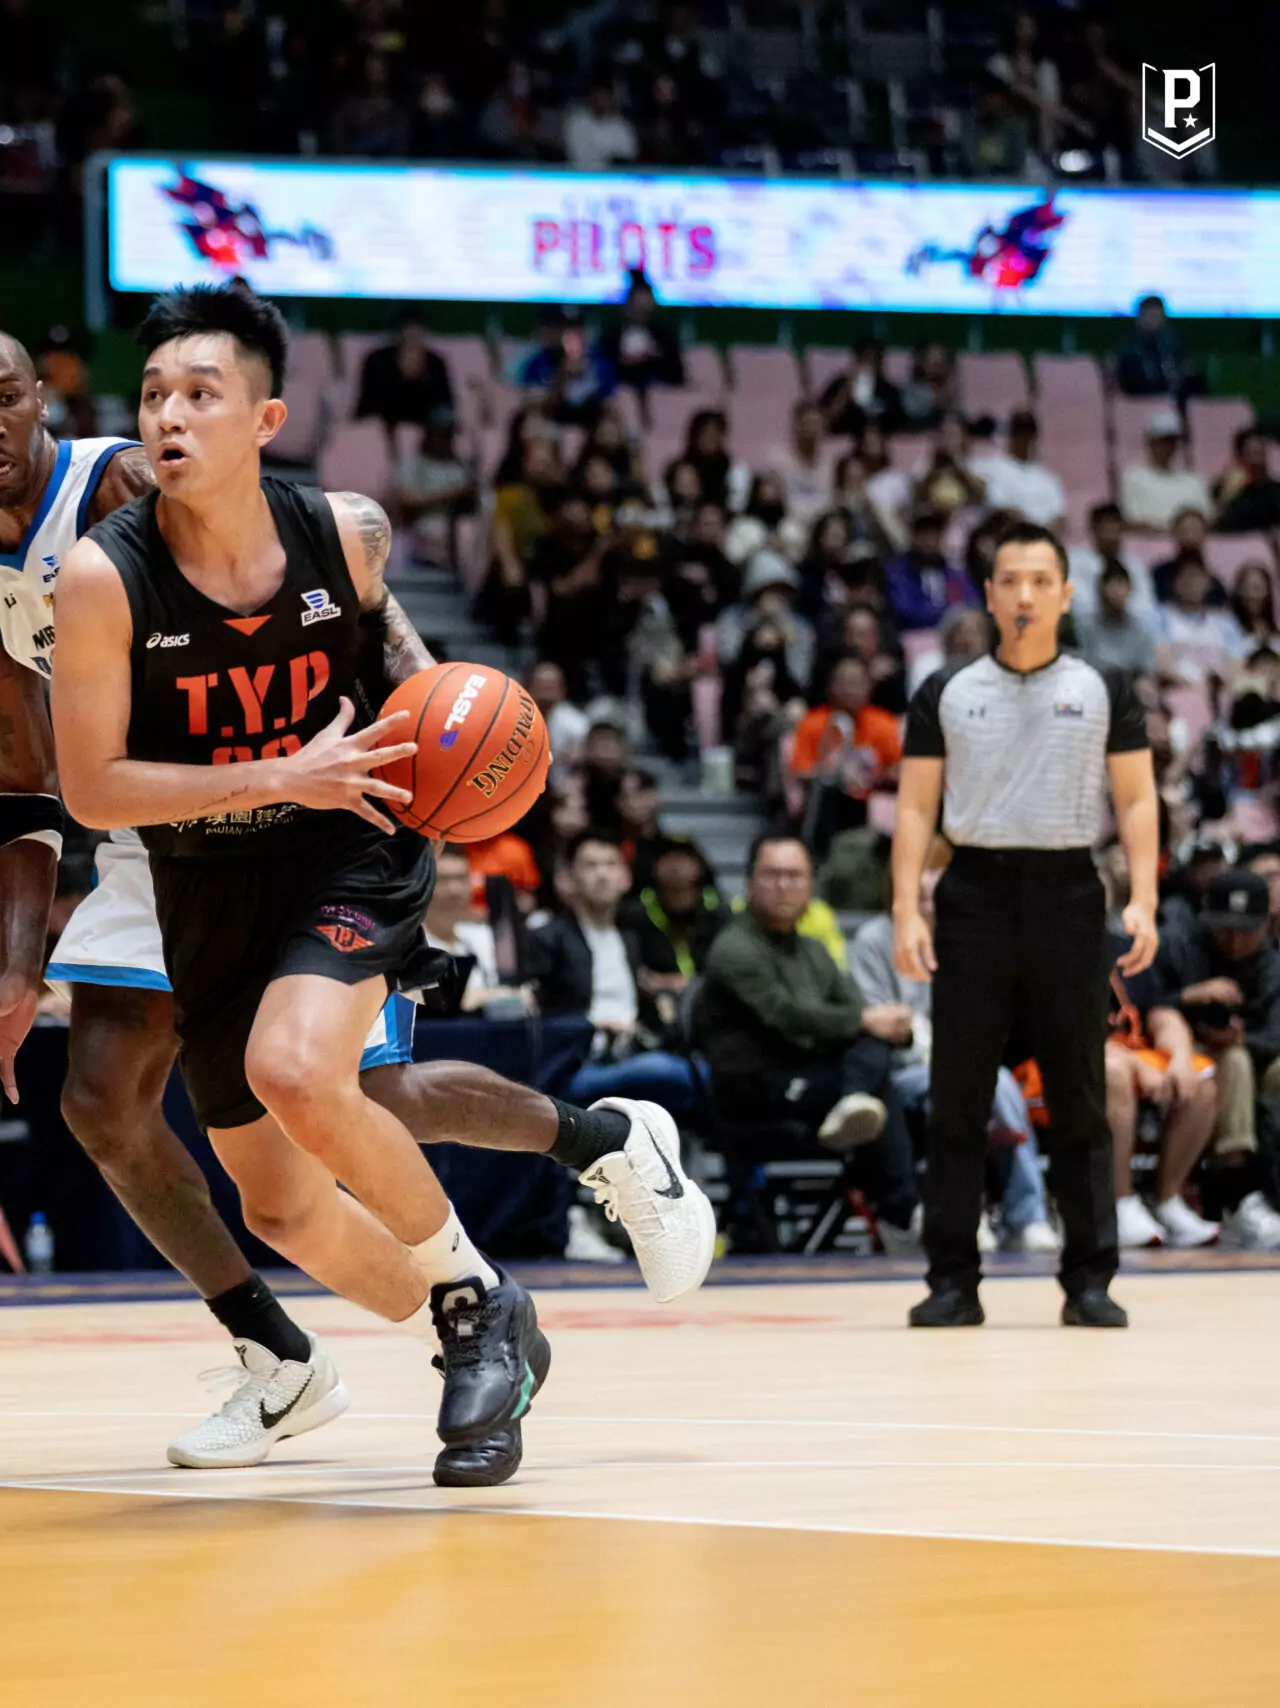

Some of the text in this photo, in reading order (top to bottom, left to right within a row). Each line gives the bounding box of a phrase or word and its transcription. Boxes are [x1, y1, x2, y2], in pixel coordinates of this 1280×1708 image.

[533, 220, 716, 277] PILOTS
[303, 606, 340, 623] EASL
[160, 633, 190, 648] asics
[444, 674, 487, 730] EASL
